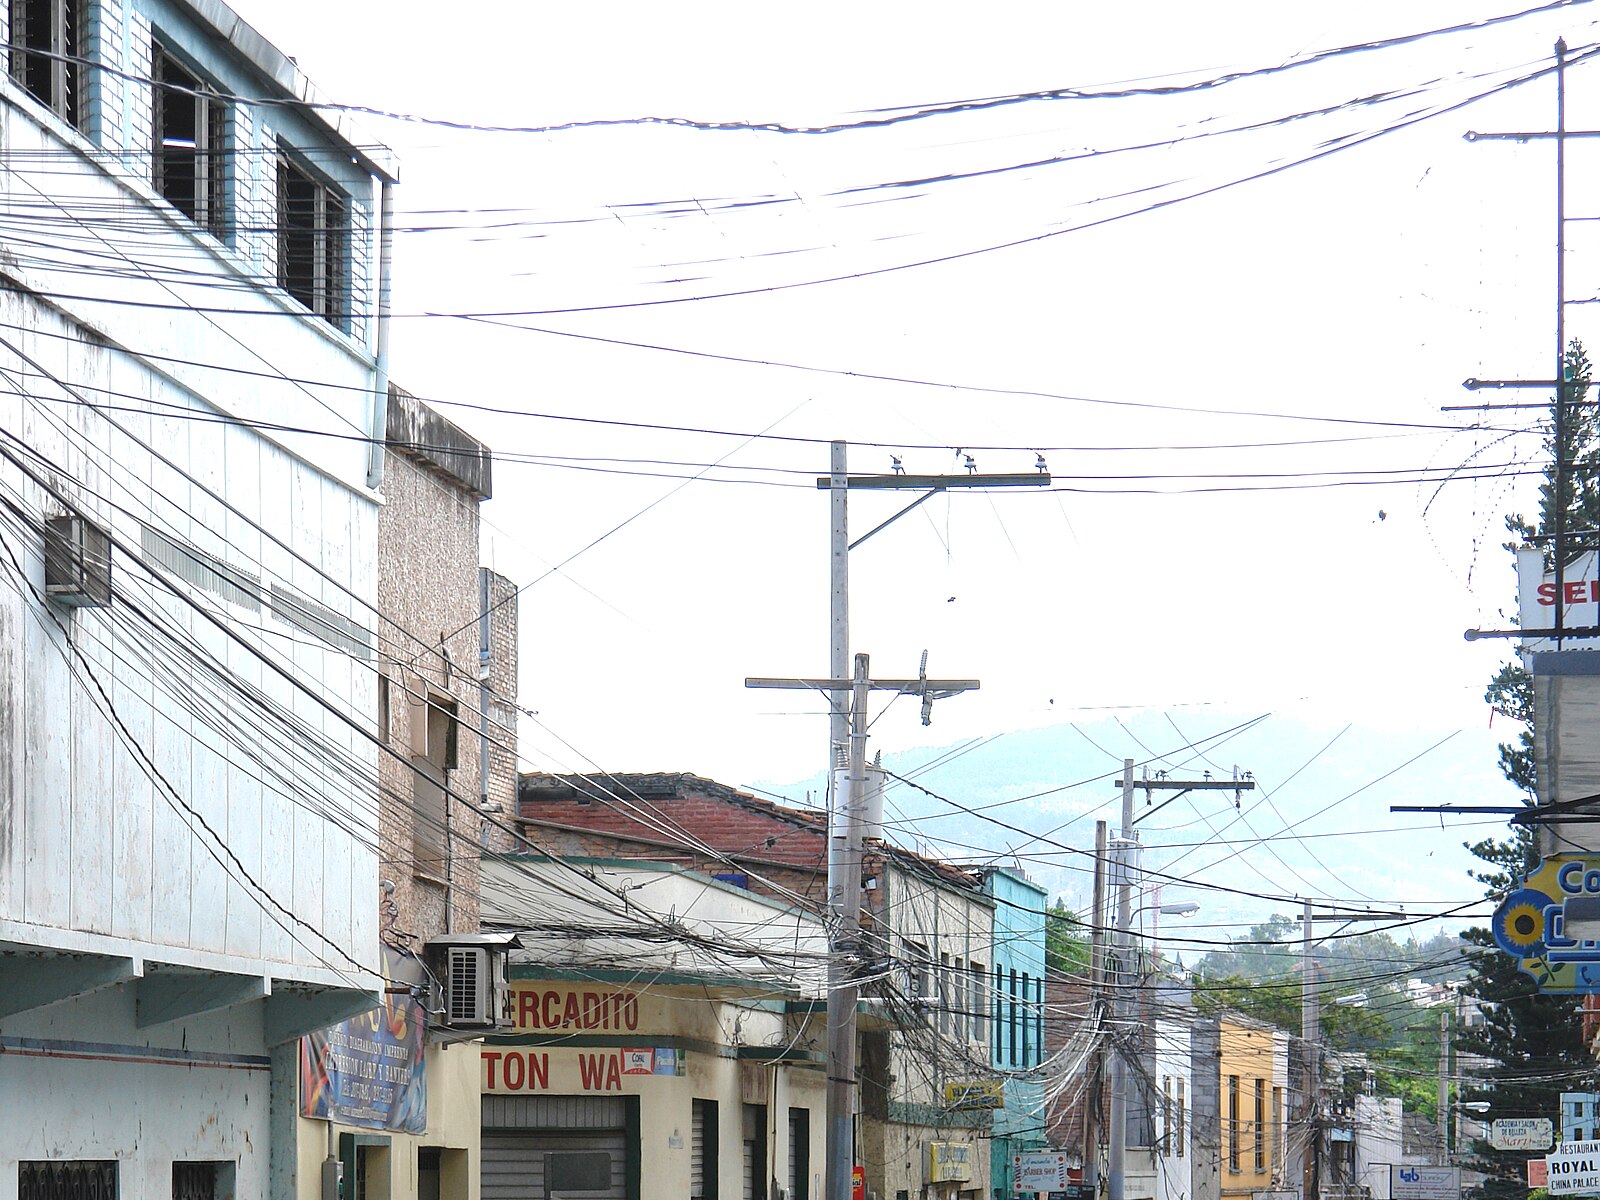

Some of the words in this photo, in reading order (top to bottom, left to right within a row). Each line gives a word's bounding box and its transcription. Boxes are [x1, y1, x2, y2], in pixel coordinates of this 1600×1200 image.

[1552, 1160, 1598, 1174] ROYAL
[1551, 1179, 1571, 1190] CHINA
[1573, 1177, 1599, 1188] PALACE
